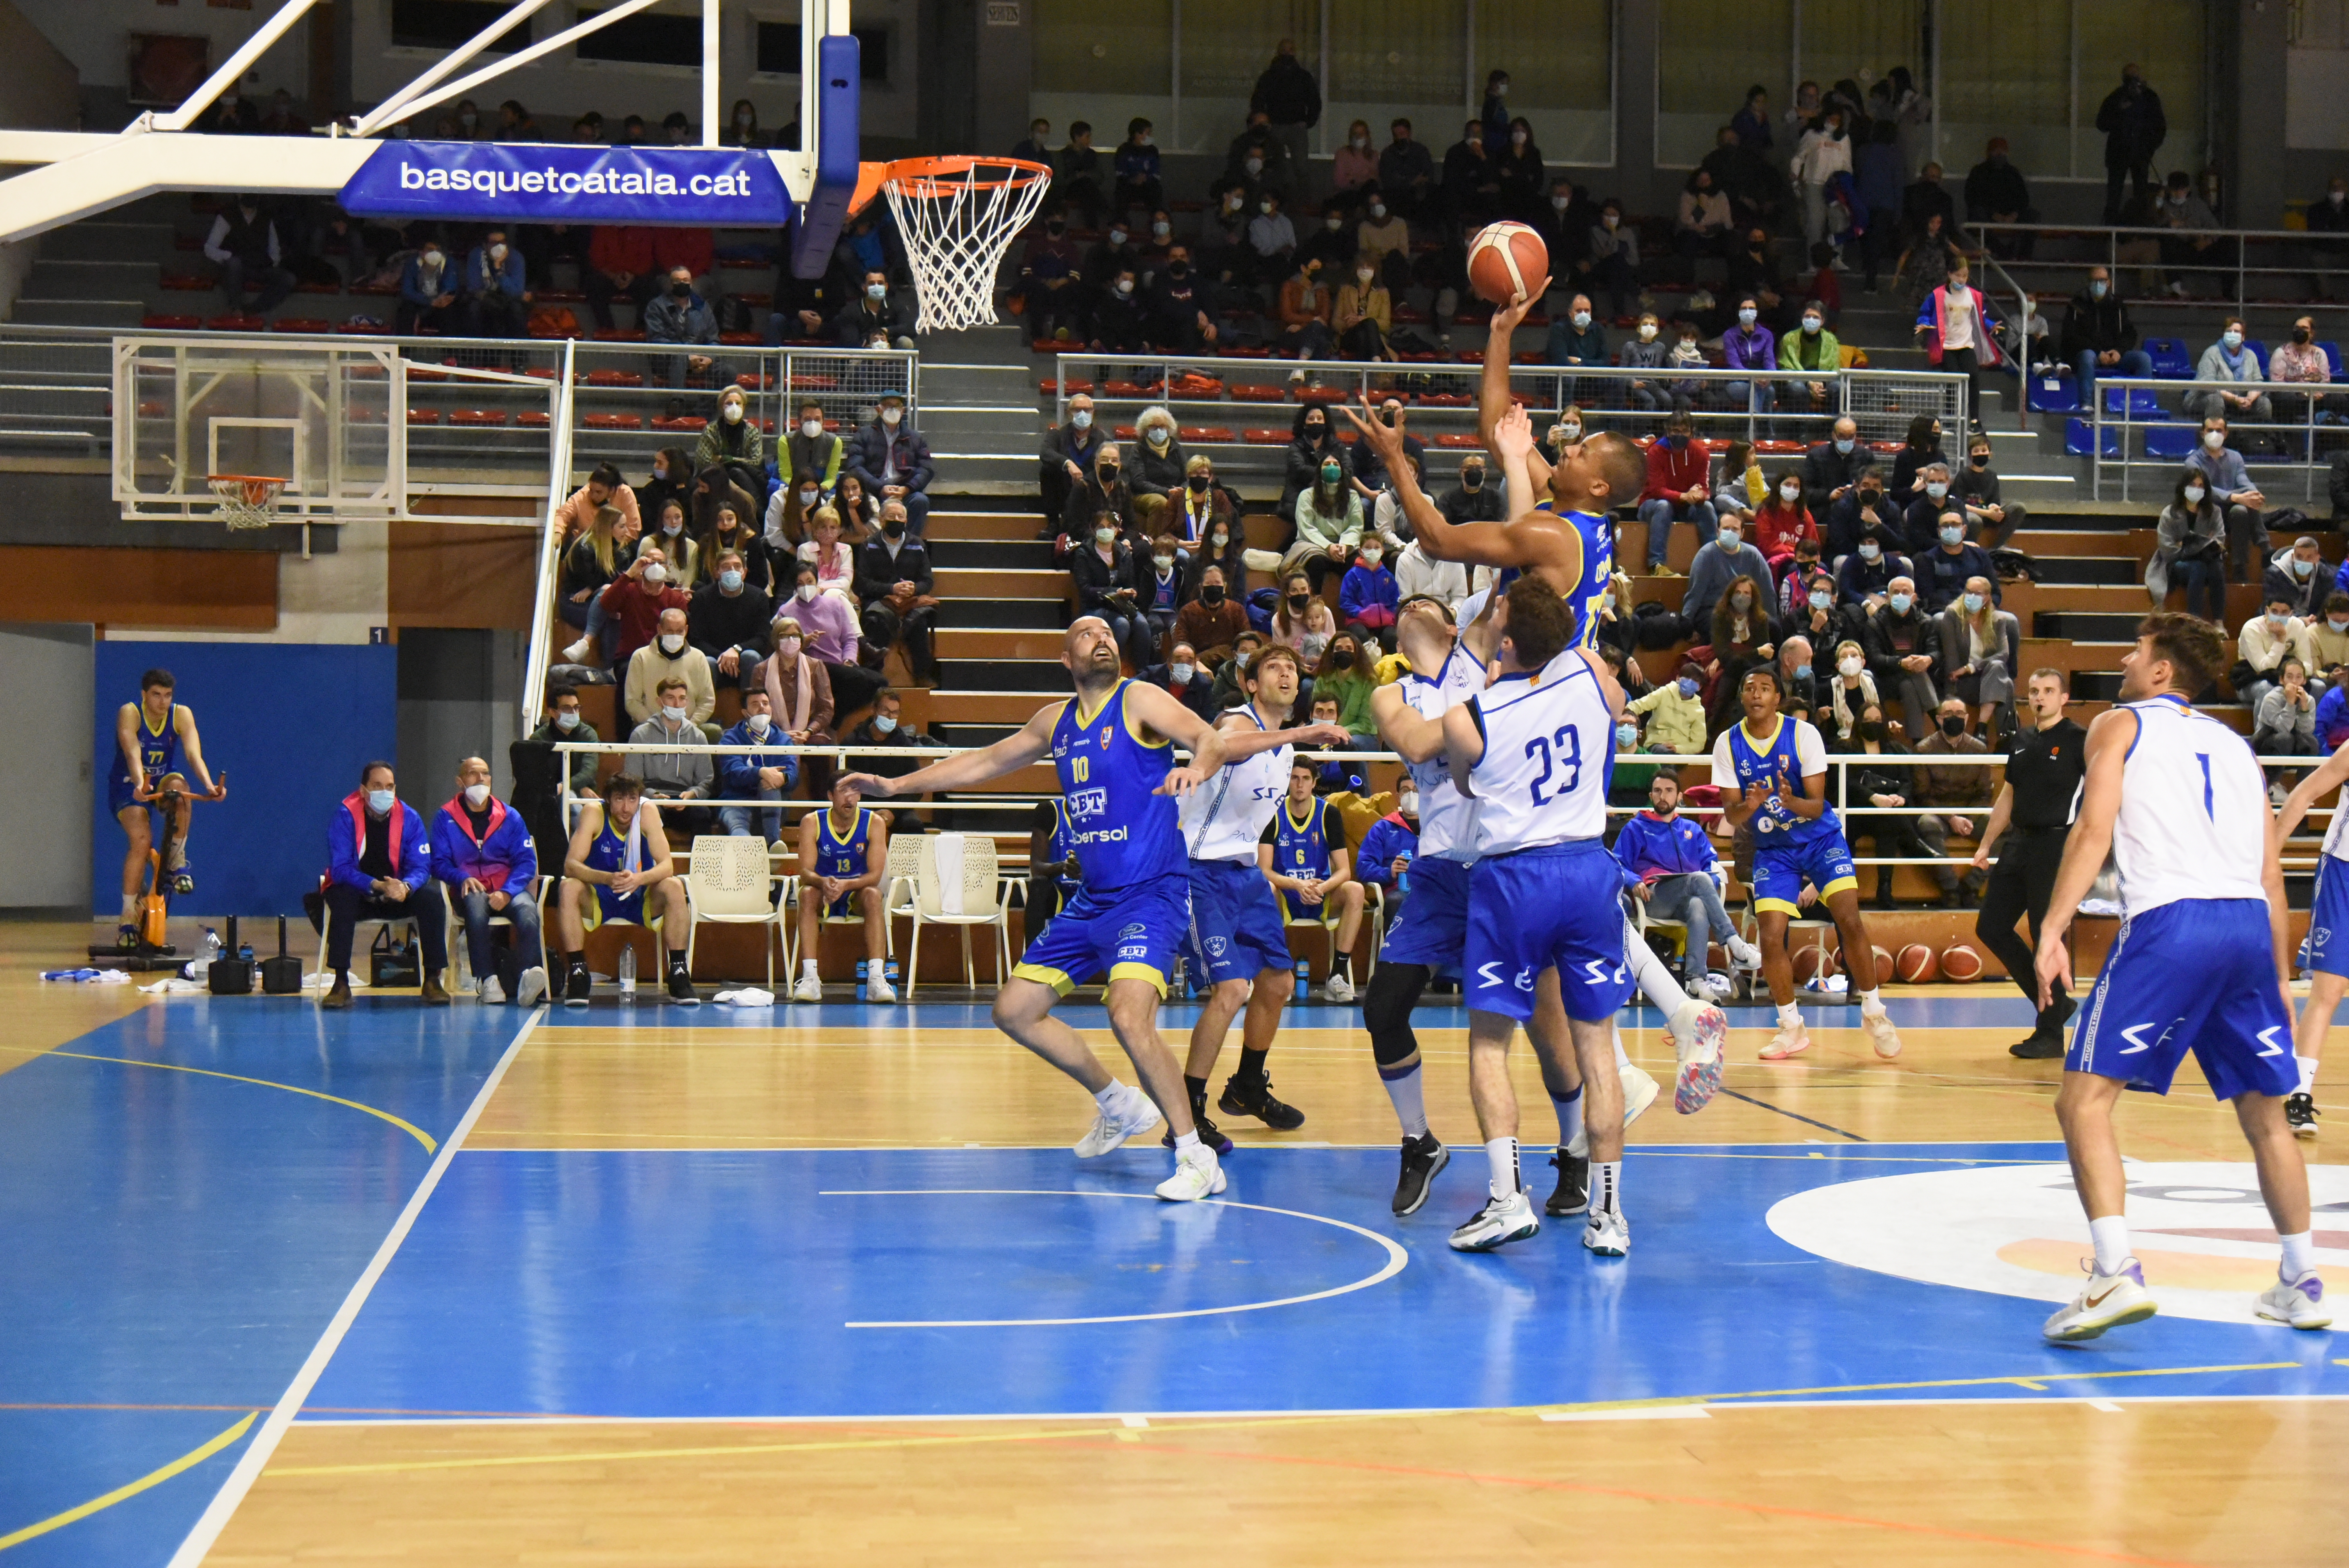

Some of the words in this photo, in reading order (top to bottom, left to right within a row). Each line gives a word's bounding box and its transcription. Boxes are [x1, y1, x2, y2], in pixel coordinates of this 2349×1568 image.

[401, 162, 750, 197] basquetcatala.cat
[375, 629, 381, 643] 1
[148, 751, 164, 764] 77
[1055, 746, 1067, 758] tac
[1071, 756, 1089, 784] 10
[1525, 724, 1582, 808] 23
[2195, 752, 2214, 825] 1
[1068, 787, 1107, 819] CBT
[1278, 837, 1289, 846] tac
[1296, 849, 1305, 864] 6
[837, 859, 850, 873] 13
[1835, 864, 1852, 874] CBT
[1118, 946, 1147, 958] CBT
